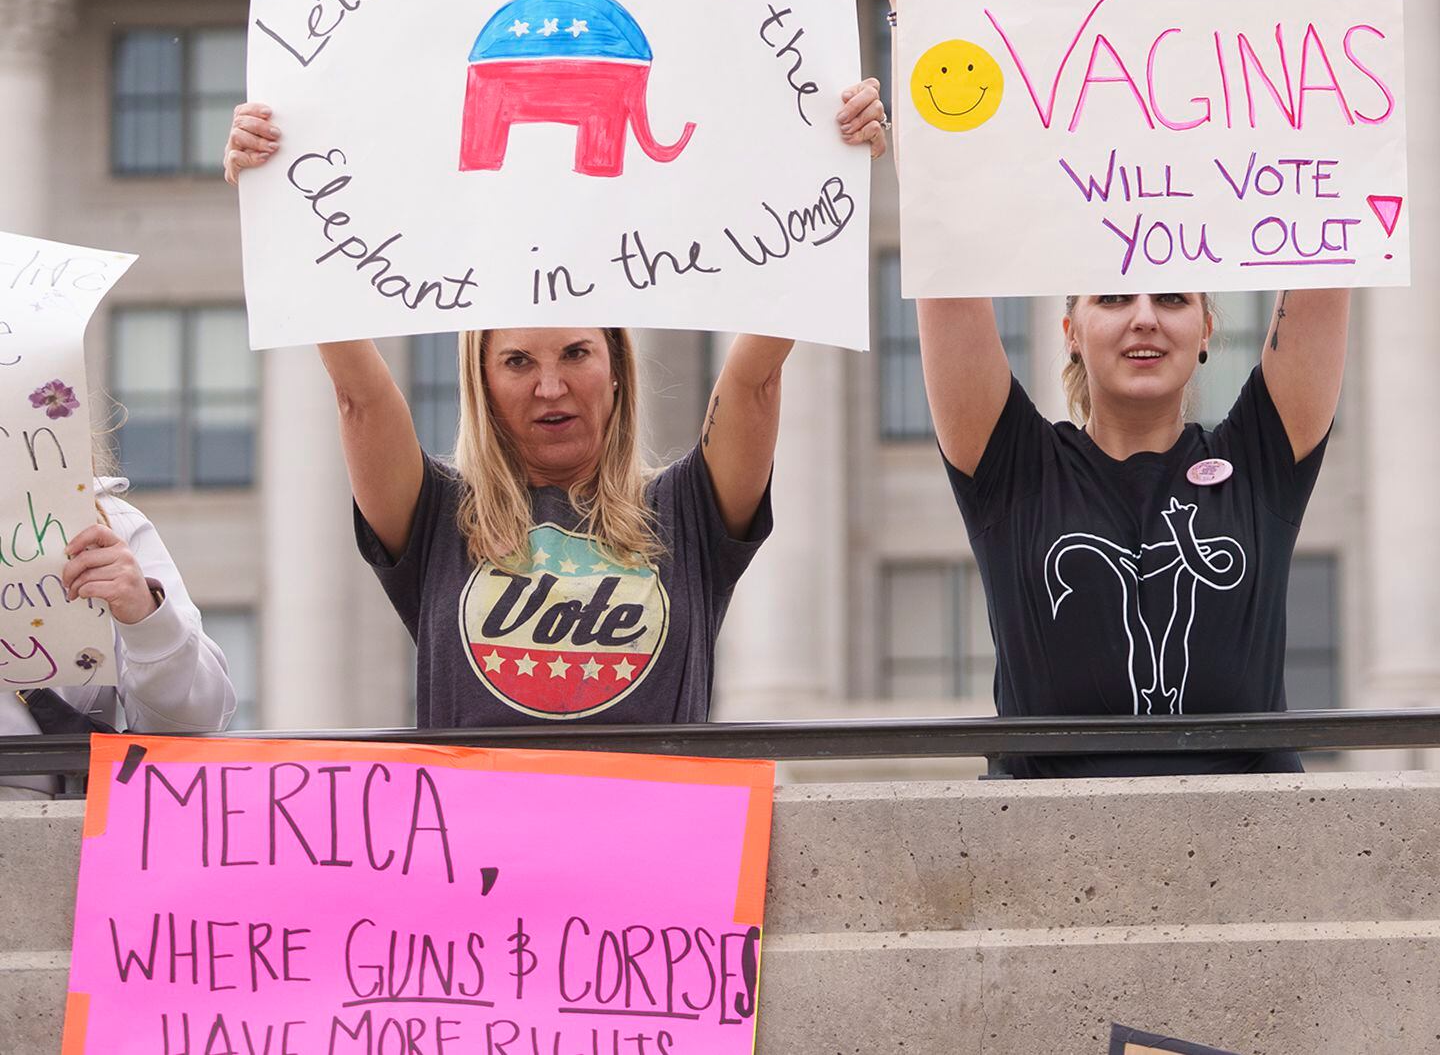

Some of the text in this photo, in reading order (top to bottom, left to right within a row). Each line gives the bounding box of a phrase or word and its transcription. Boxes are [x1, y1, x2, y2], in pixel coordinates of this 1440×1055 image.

[759, 3, 820, 126] the
[287, 149, 479, 310] Elephant
[531, 247, 595, 305] in
[612, 232, 721, 291] the
[1058, 149, 1340, 203] WILL VOTE
[1102, 214, 1222, 276] YOU
[481, 568, 648, 646] Vote
[115, 745, 499, 896] 'MERICA,
[110, 912, 311, 992] WHERE
[344, 918, 485, 999] GUNS
[558, 916, 761, 1024] CORPSES
